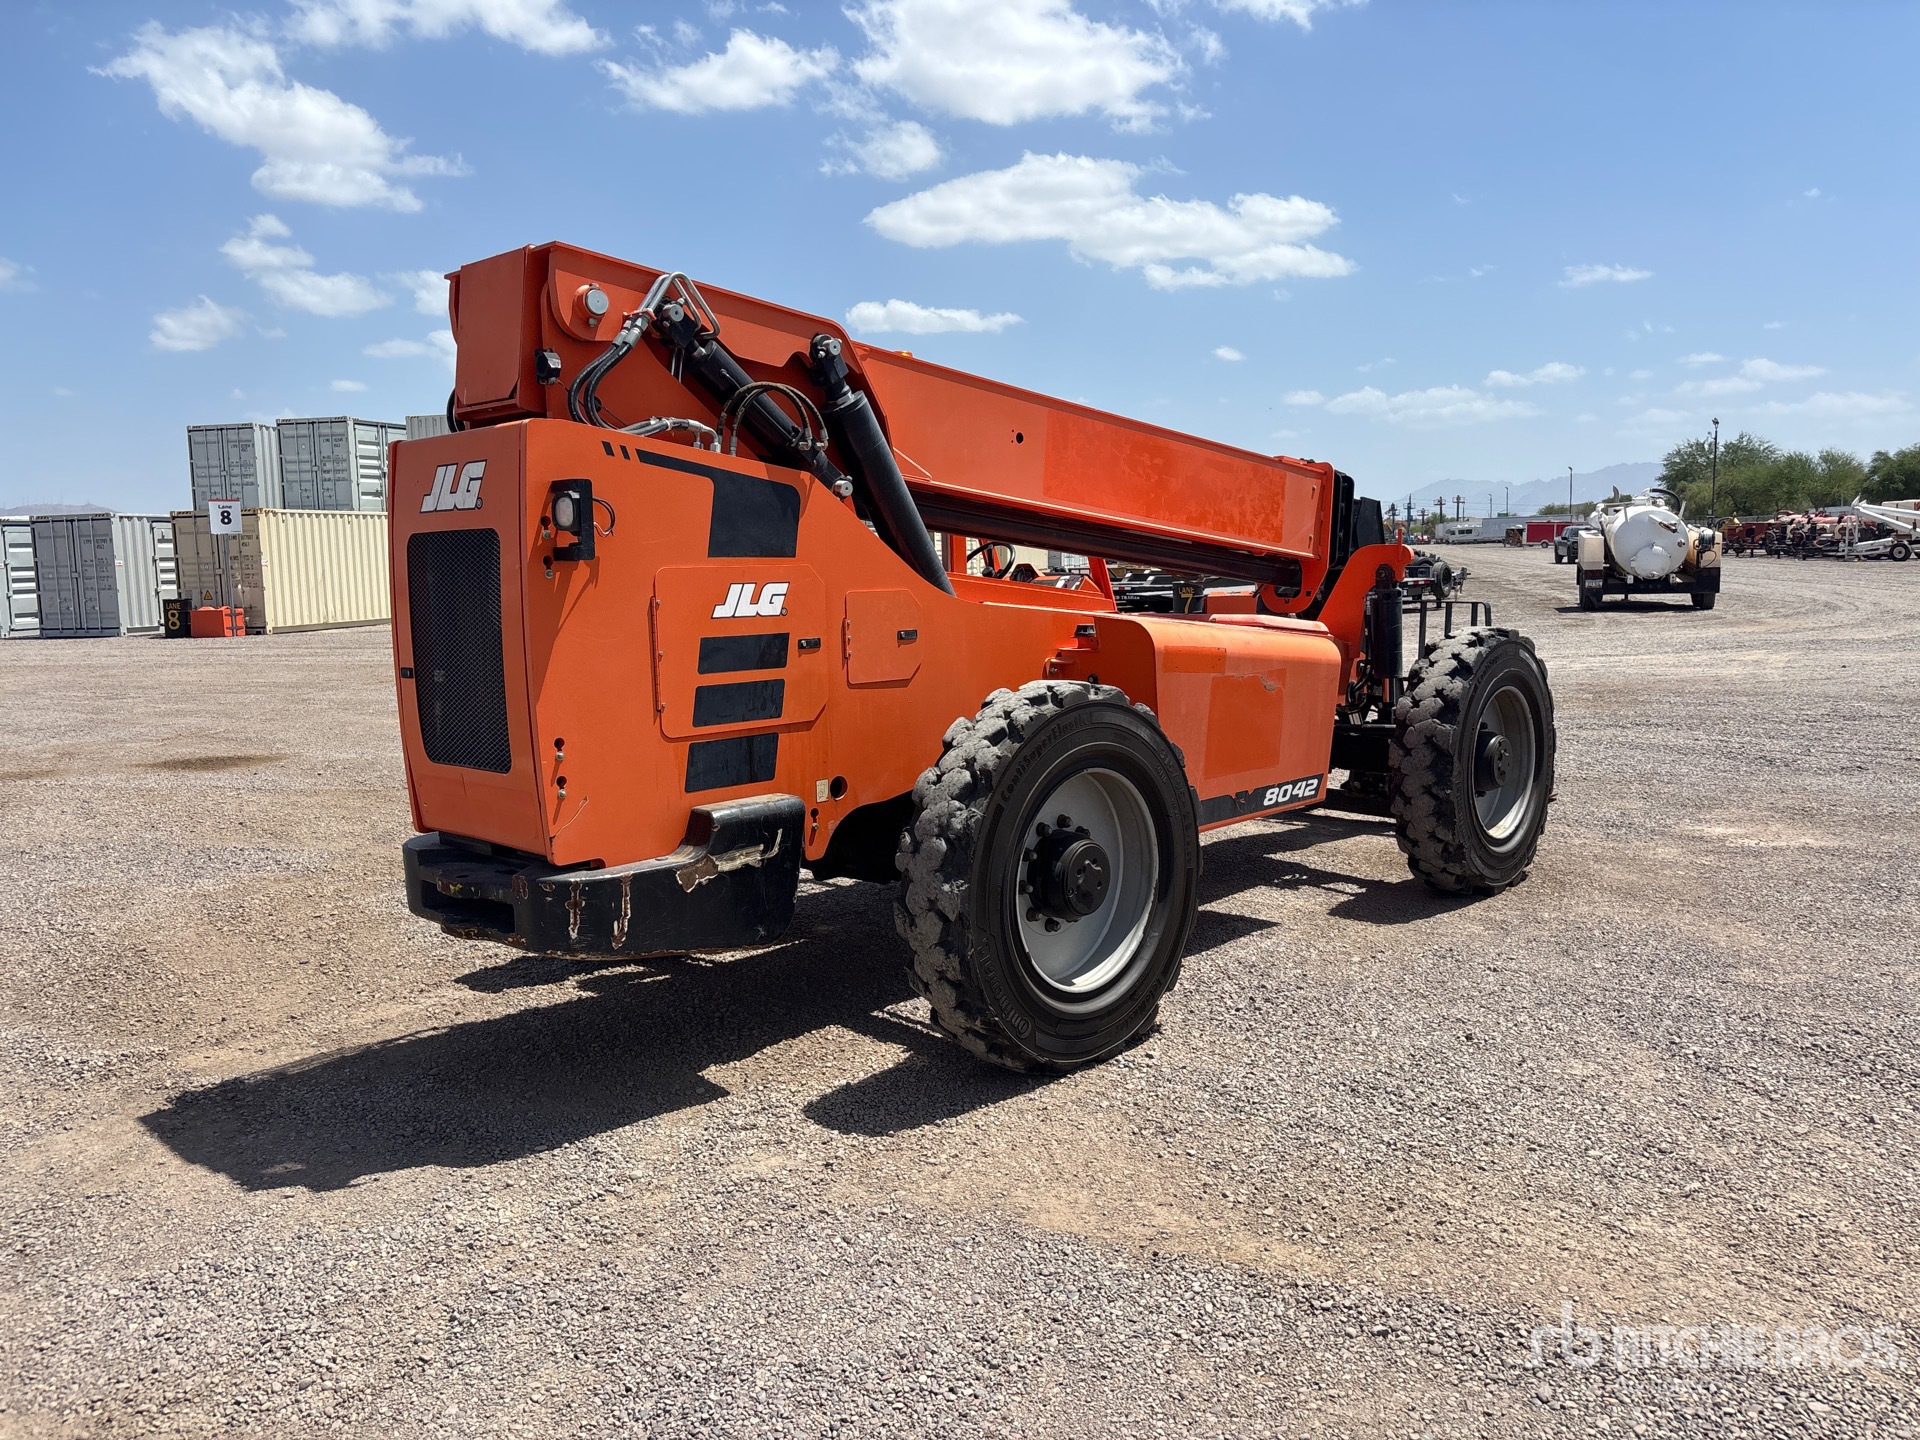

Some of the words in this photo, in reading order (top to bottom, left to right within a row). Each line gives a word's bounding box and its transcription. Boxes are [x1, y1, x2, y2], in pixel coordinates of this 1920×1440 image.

[420, 459, 487, 514] JLG
[220, 510, 232, 525] 8
[711, 582, 790, 619] JLG
[1178, 586, 1195, 595] LANE
[165, 602, 181, 610] LANE
[1181, 593, 1193, 614] 7
[168, 609, 180, 630] 8
[1263, 778, 1319, 806] 8042
